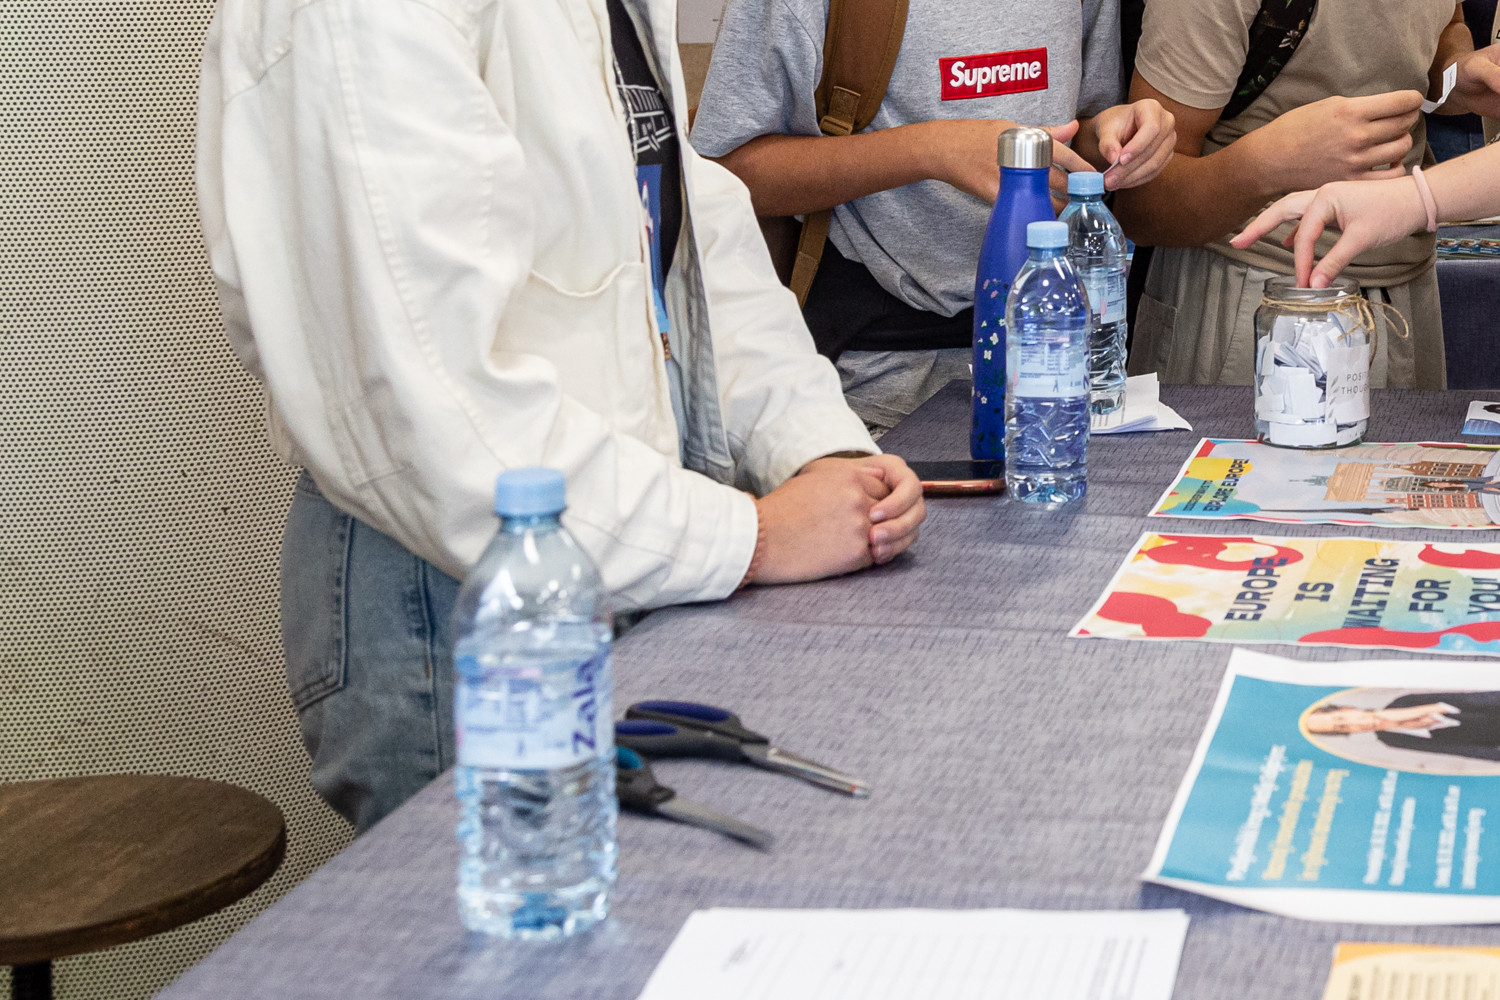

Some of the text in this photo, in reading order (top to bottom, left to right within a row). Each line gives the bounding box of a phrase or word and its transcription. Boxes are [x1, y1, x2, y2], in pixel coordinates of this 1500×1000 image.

[949, 60, 1042, 94] Supreme
[1224, 557, 1288, 622] EUROPE
[1294, 581, 1334, 602] IS
[1341, 557, 1400, 629] WAITING
[1408, 578, 1452, 613] FOR
